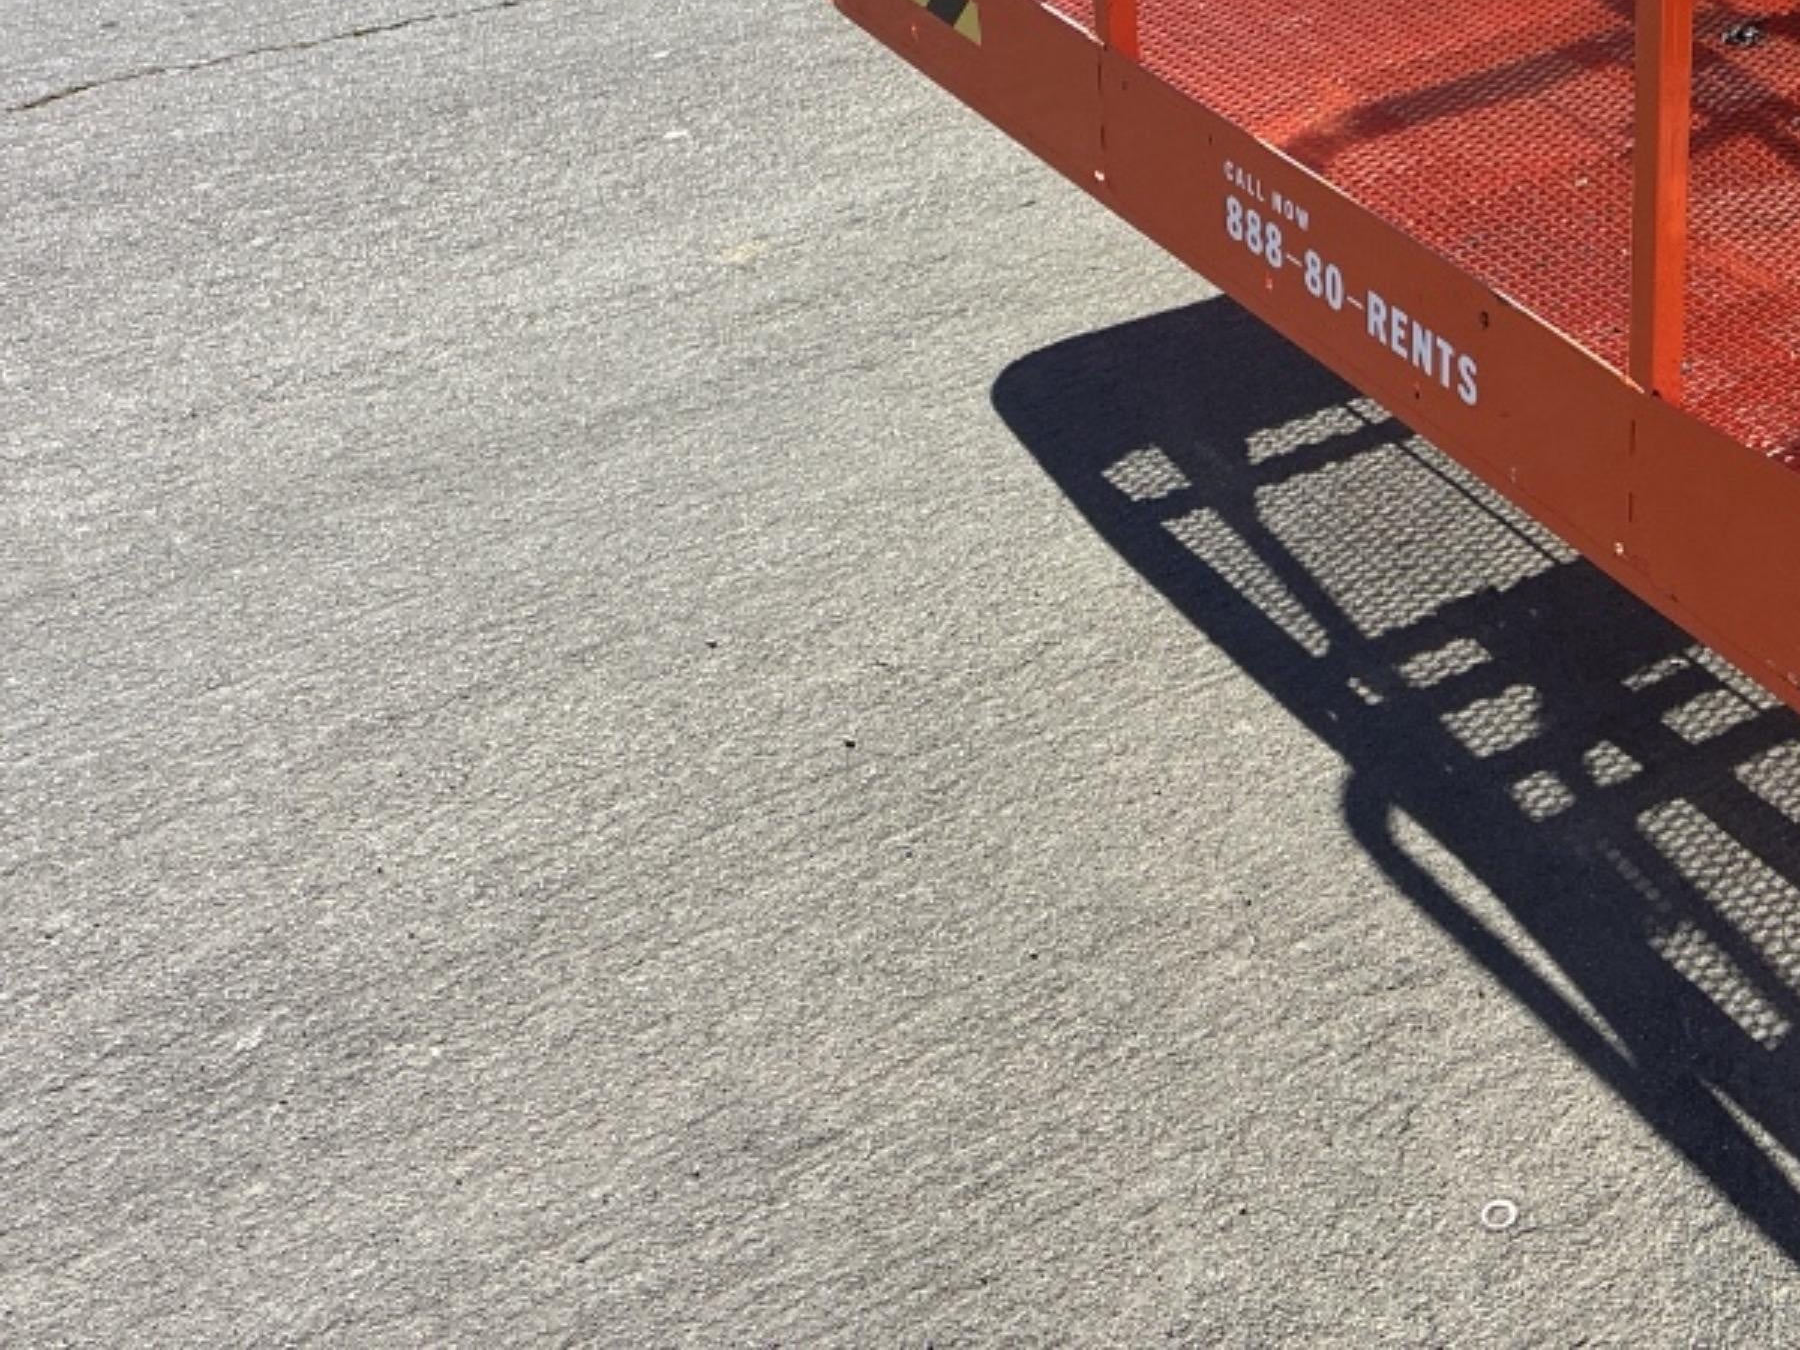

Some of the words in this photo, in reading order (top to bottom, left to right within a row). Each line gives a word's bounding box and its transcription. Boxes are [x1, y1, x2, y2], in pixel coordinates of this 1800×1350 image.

[1223, 160, 1264, 202] CALL
[1271, 191, 1309, 231] NOW
[1225, 195, 1478, 406] 888-80-RENTS
